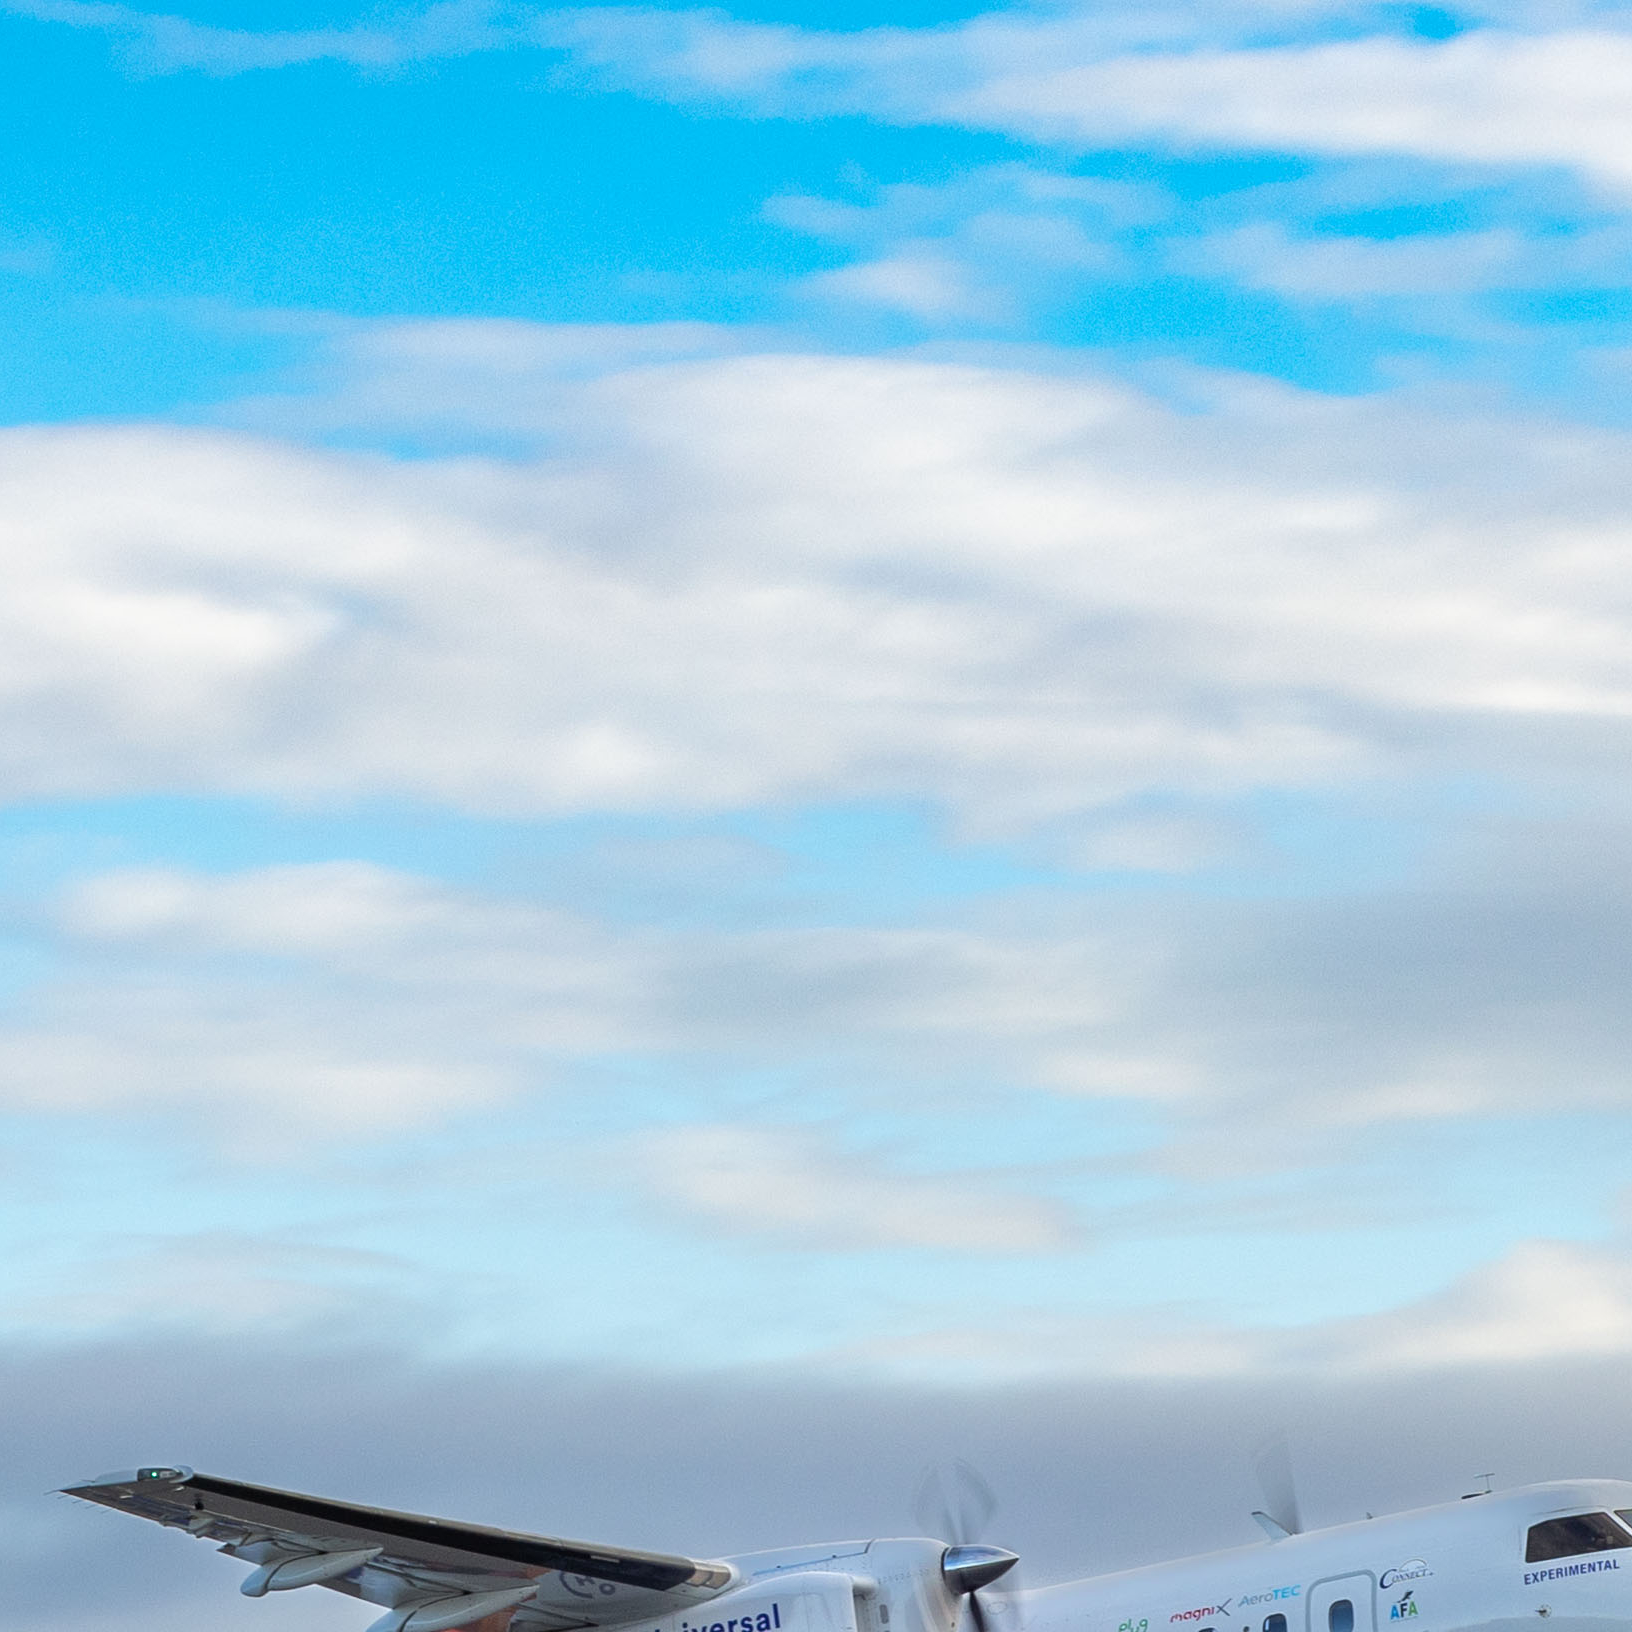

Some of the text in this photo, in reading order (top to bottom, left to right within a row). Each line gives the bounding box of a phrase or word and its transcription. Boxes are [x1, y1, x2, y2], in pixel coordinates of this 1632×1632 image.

[1523, 1558, 1621, 1586] EXPERIMENTAL
[1238, 1584, 1302, 1608] AeroTEC
[1390, 1601, 1419, 1620] AFA
